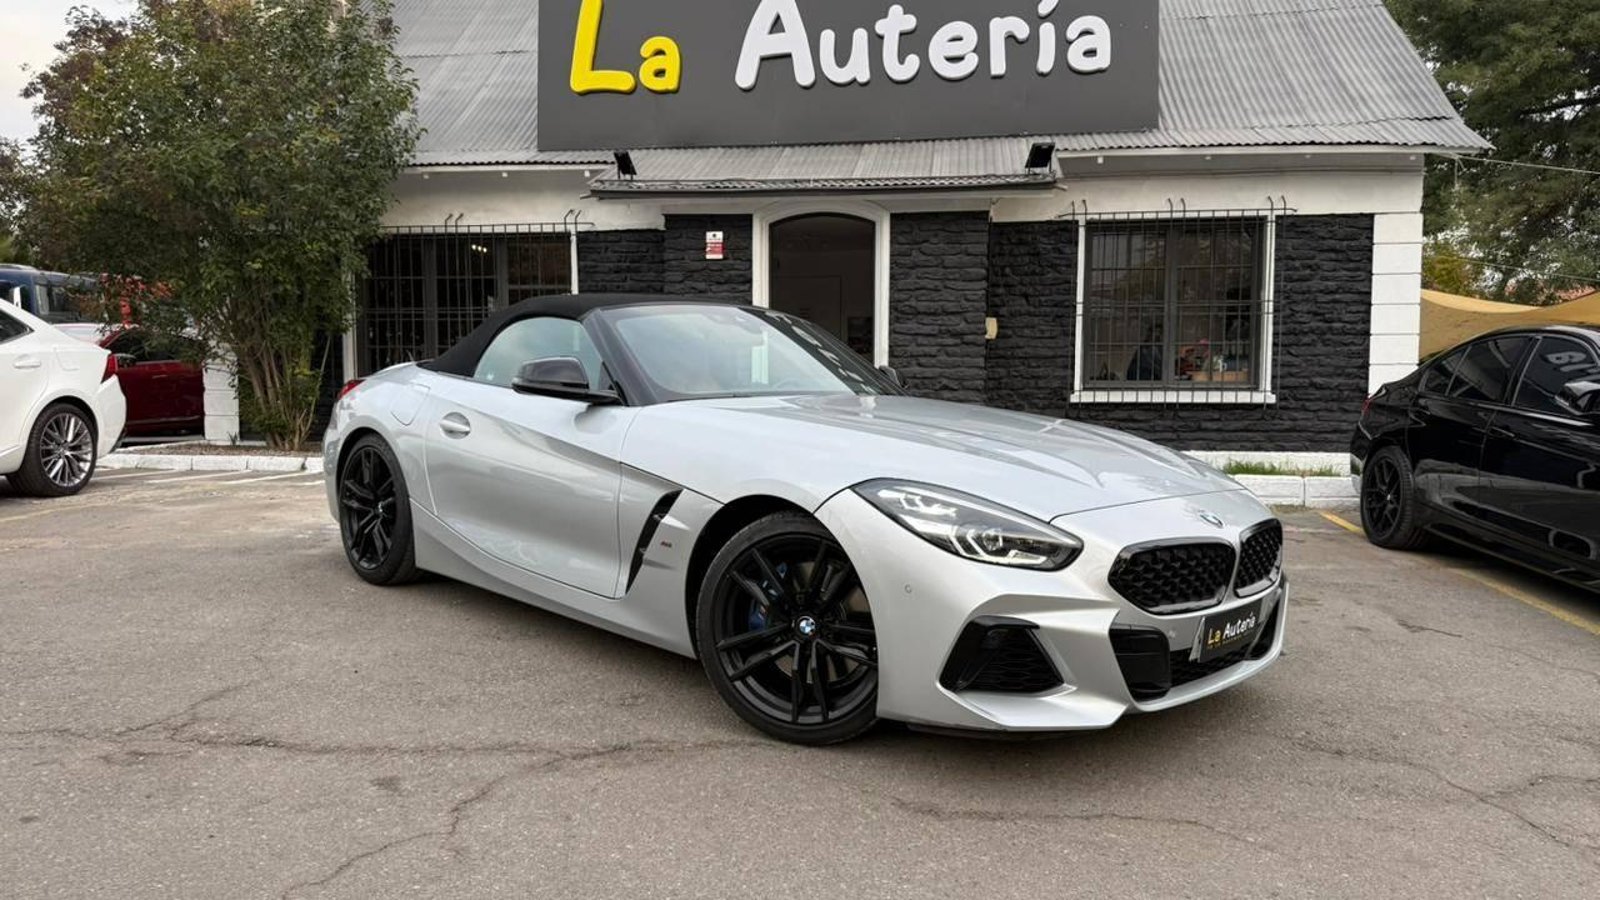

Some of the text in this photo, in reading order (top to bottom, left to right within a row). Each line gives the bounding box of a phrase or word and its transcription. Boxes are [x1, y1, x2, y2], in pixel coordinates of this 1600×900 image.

[569, 0, 1112, 93] La Autería
[1207, 628, 1221, 645] La
